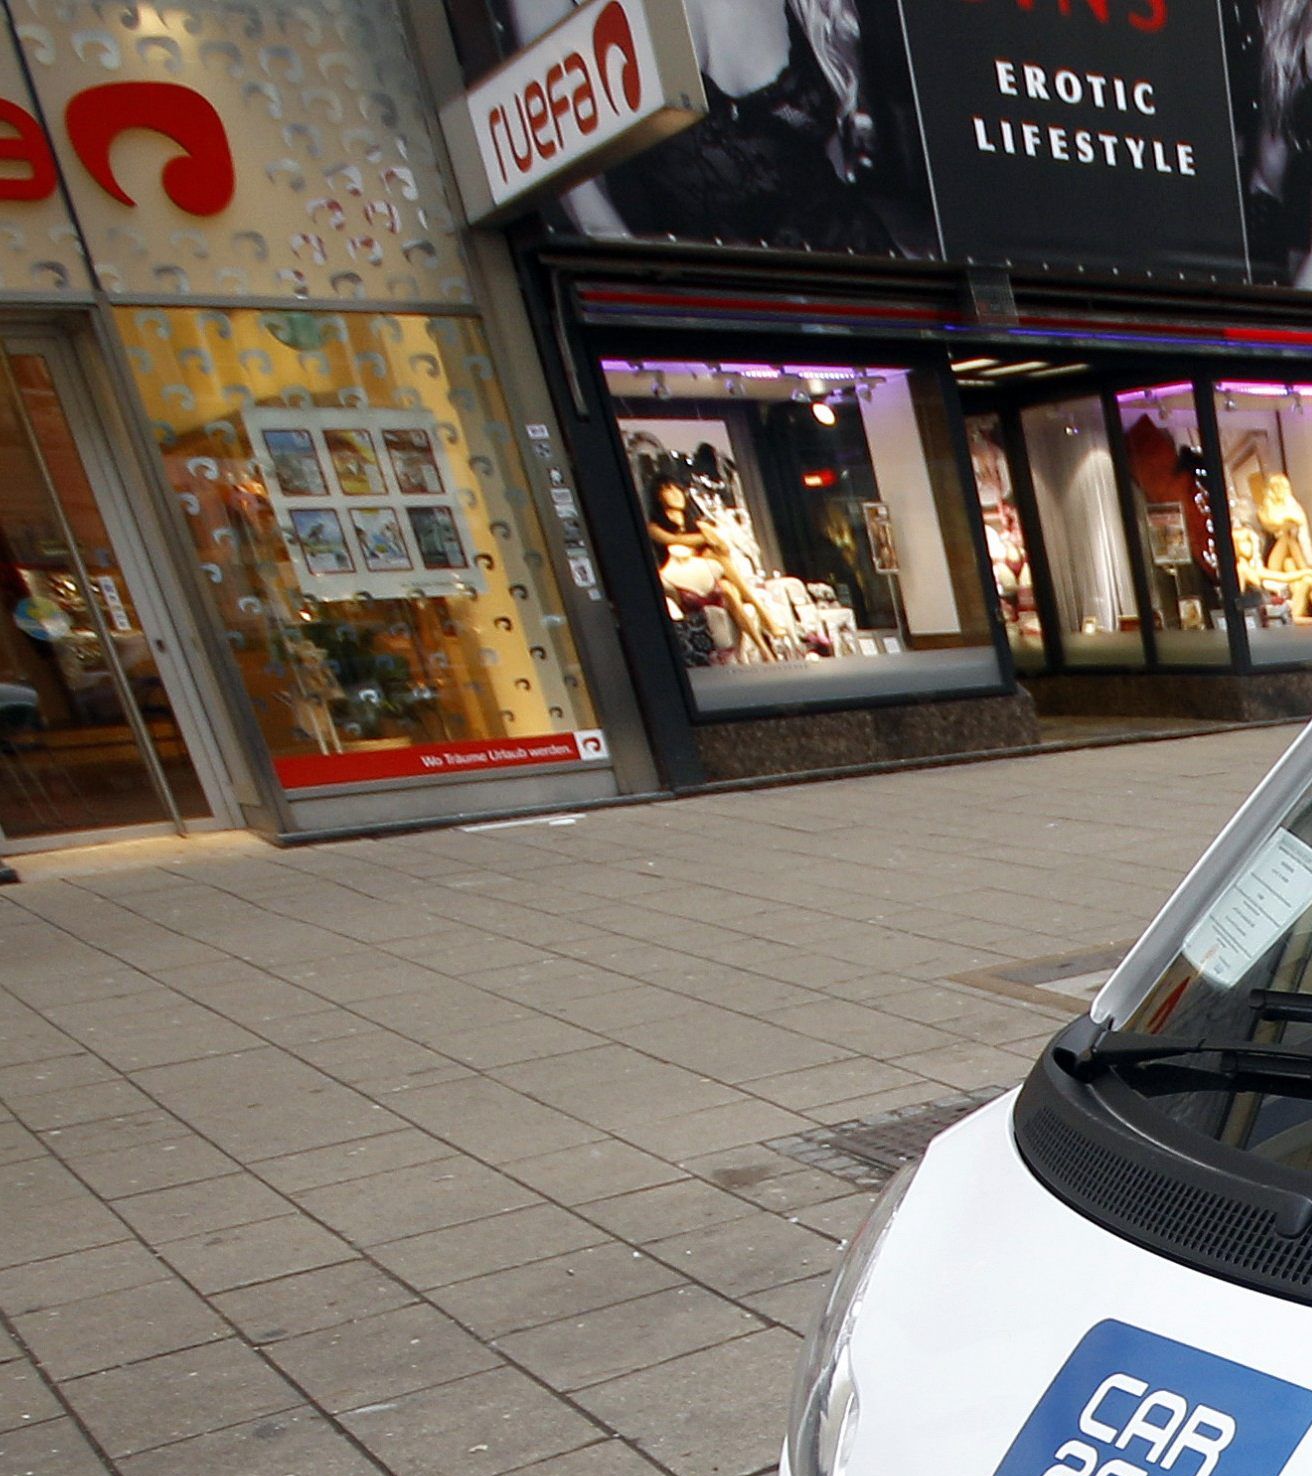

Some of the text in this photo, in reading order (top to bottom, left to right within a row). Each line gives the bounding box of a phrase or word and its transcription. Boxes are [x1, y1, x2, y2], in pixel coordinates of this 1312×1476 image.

[995, 60, 1156, 116] EROTIC
[973, 117, 1196, 176] LIFESTYLE
[420, 755, 442, 768] Wo
[488, 747, 527, 762] Urlaub
